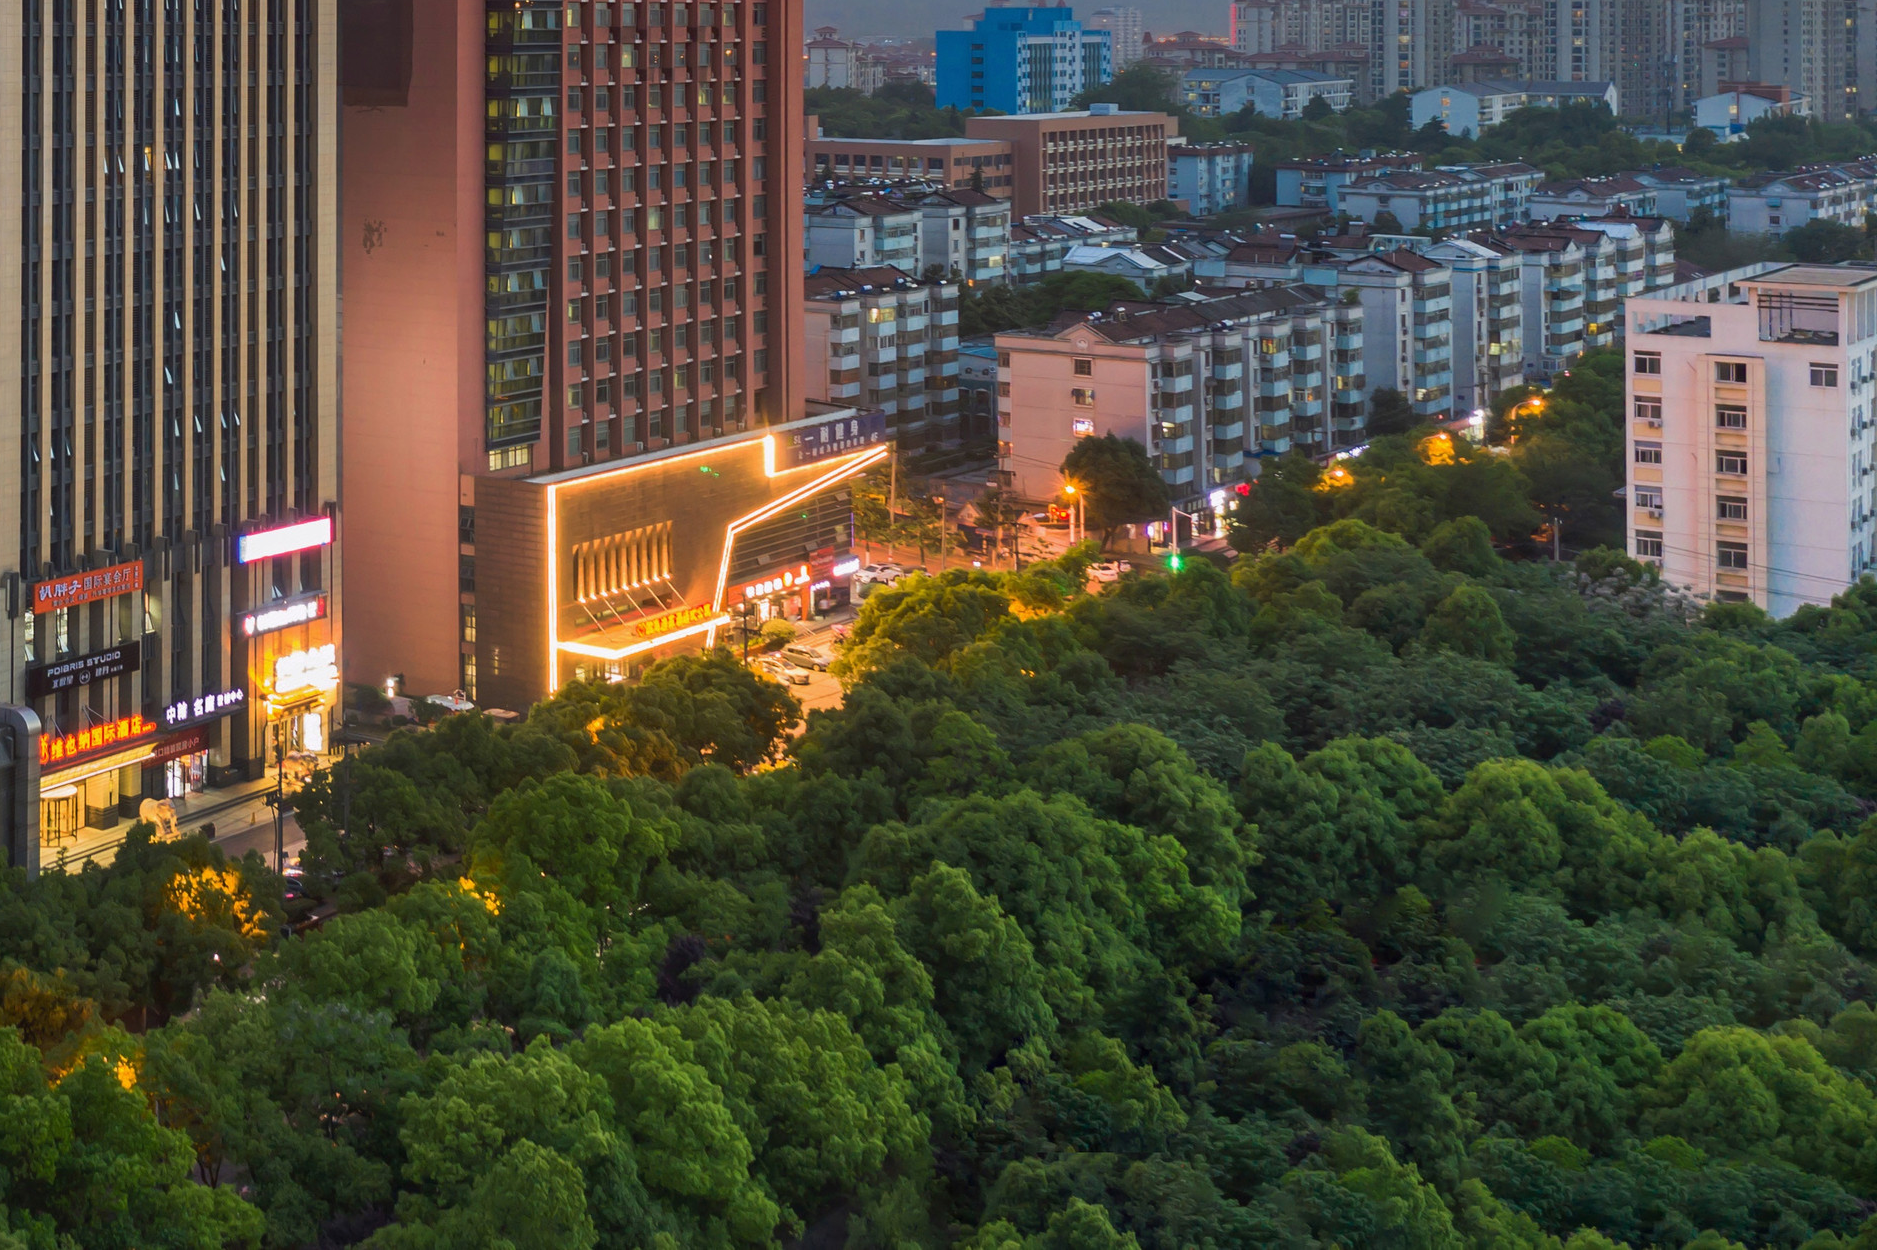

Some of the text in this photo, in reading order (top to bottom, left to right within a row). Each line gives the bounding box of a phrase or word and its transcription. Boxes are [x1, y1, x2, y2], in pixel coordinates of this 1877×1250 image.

[86, 650, 121, 667] STUDIO
[51, 715, 142, 761] 维也纳国际酒店
